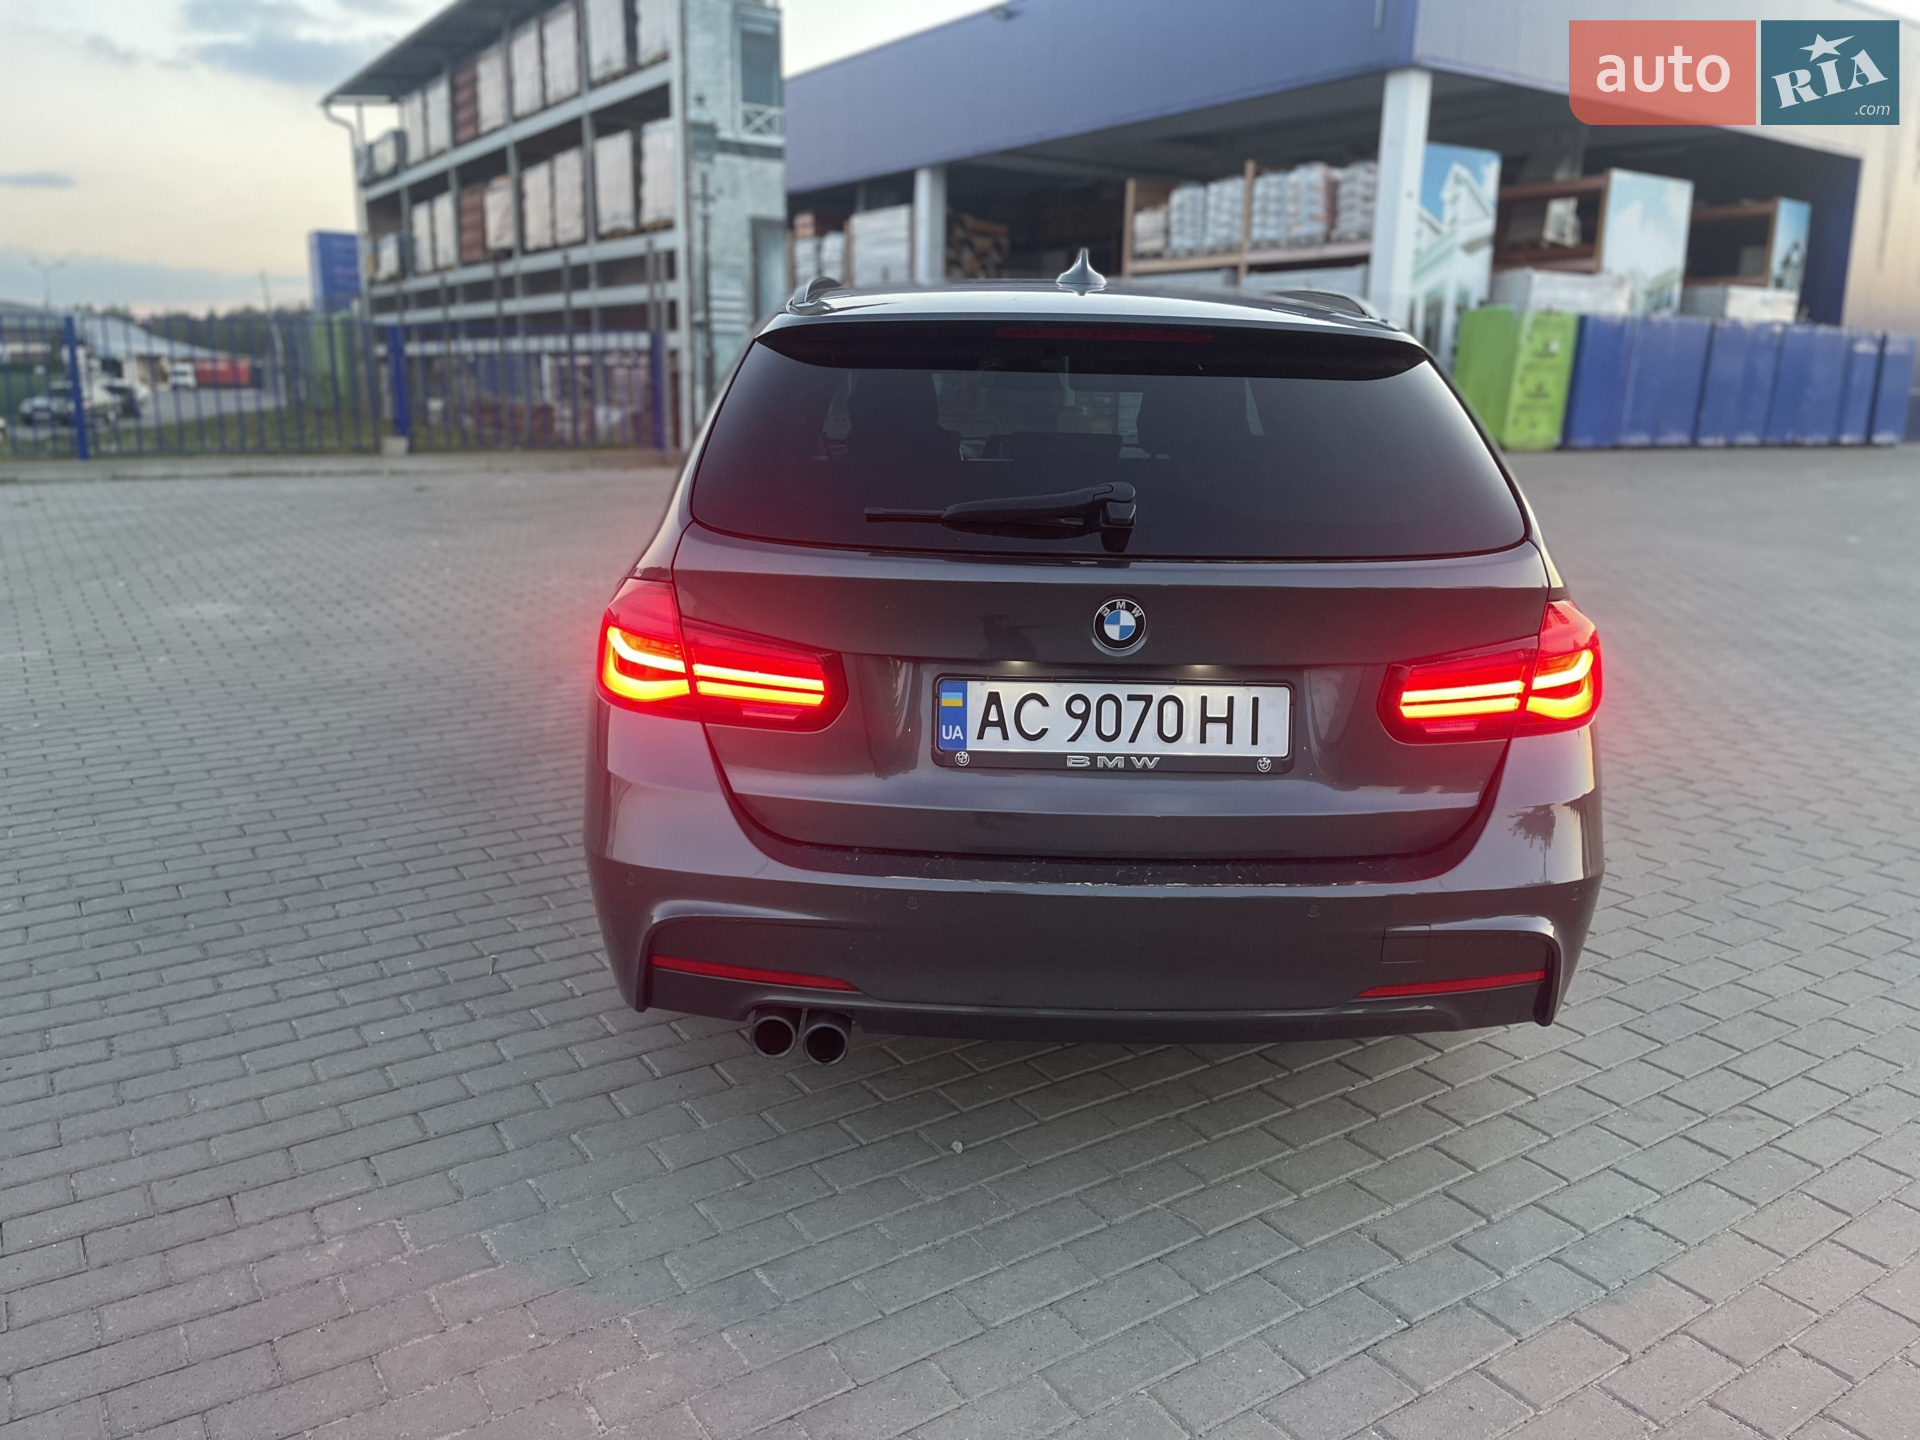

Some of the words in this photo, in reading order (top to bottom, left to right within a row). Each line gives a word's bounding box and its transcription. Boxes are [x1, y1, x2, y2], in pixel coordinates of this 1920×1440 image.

[1099, 601, 1143, 618] BMW
[976, 691, 1050, 742] AC
[1065, 693, 1184, 744] 9070
[1199, 695, 1259, 746] HI
[942, 725, 964, 741] UA
[1066, 755, 1161, 769] BMW
